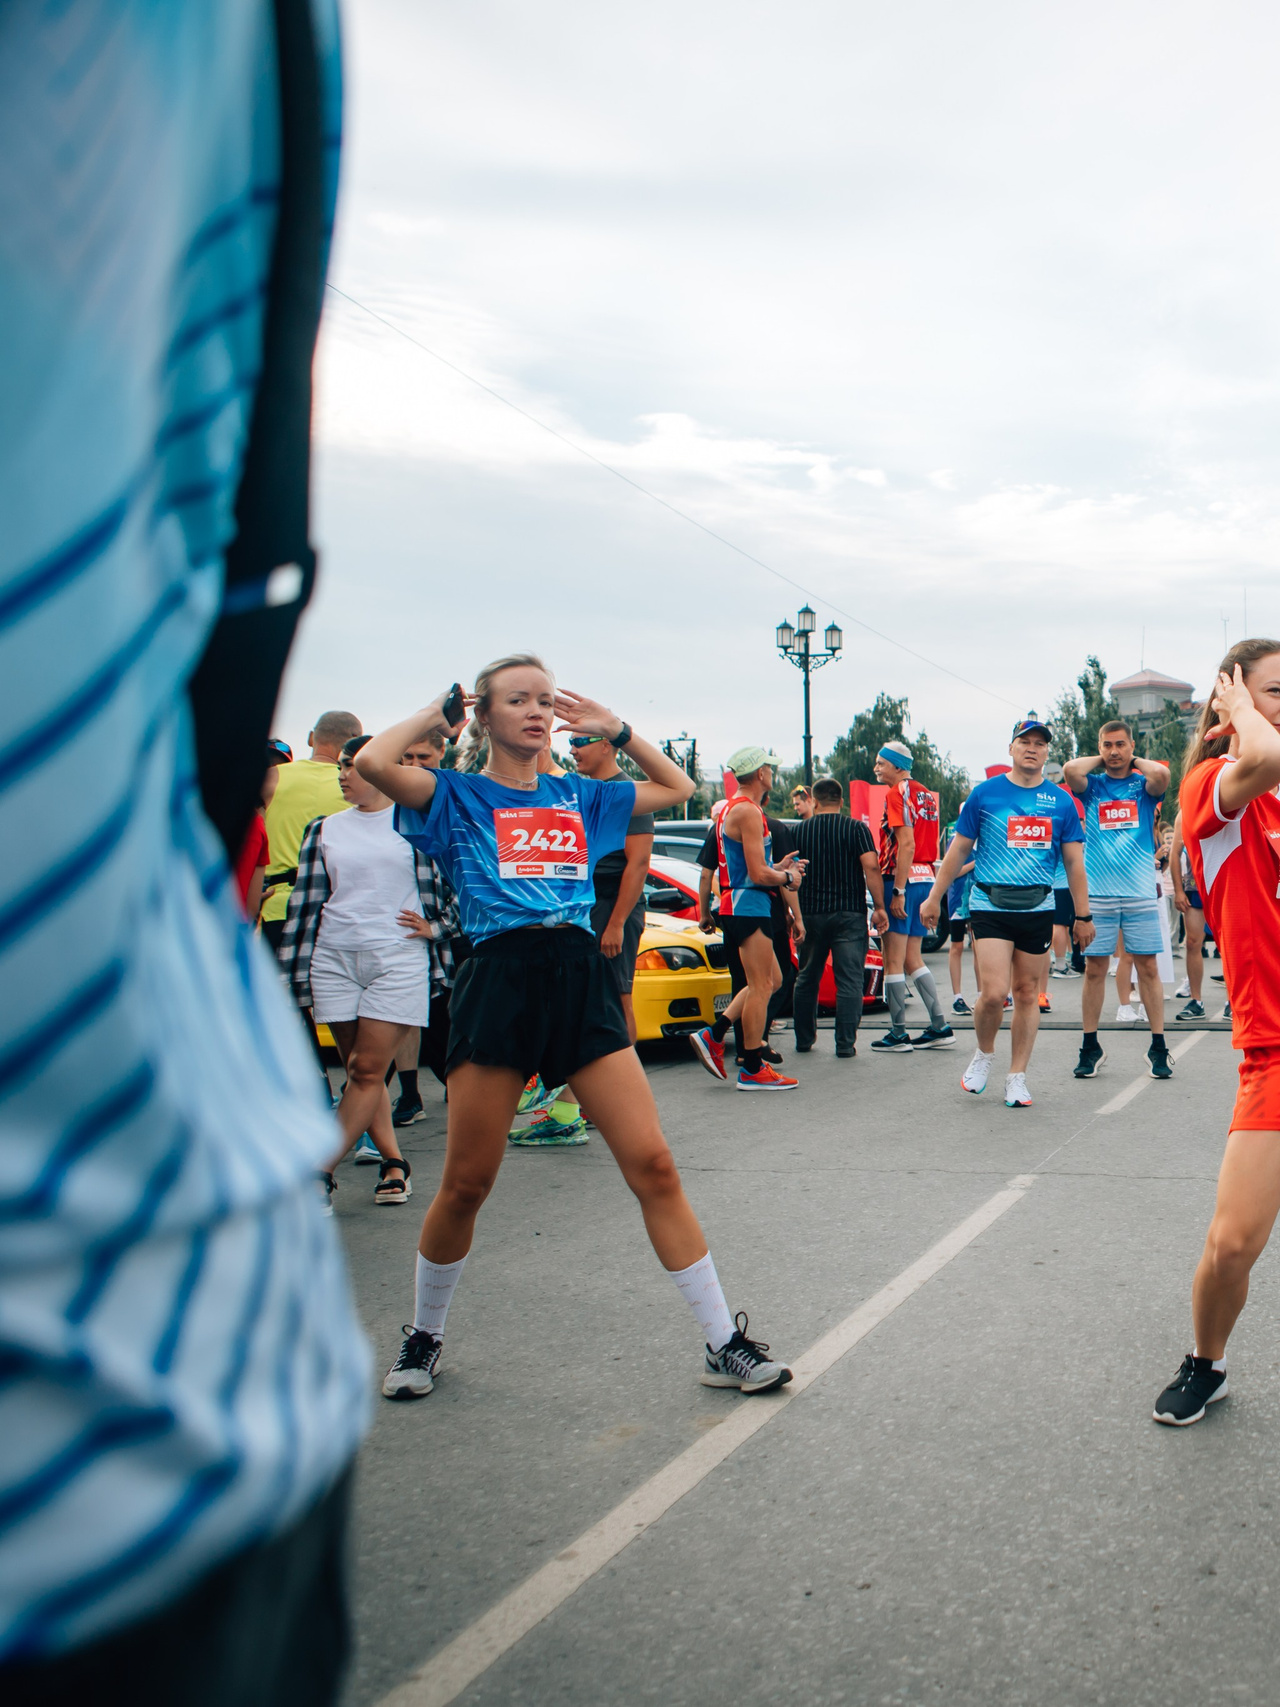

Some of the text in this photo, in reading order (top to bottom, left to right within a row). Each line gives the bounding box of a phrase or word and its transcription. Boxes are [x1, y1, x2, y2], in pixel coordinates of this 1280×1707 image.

[1105, 808, 1131, 819] 1861
[1014, 825, 1046, 838] 2491
[511, 828, 578, 852] 2422
[911, 865, 930, 875] 1055
